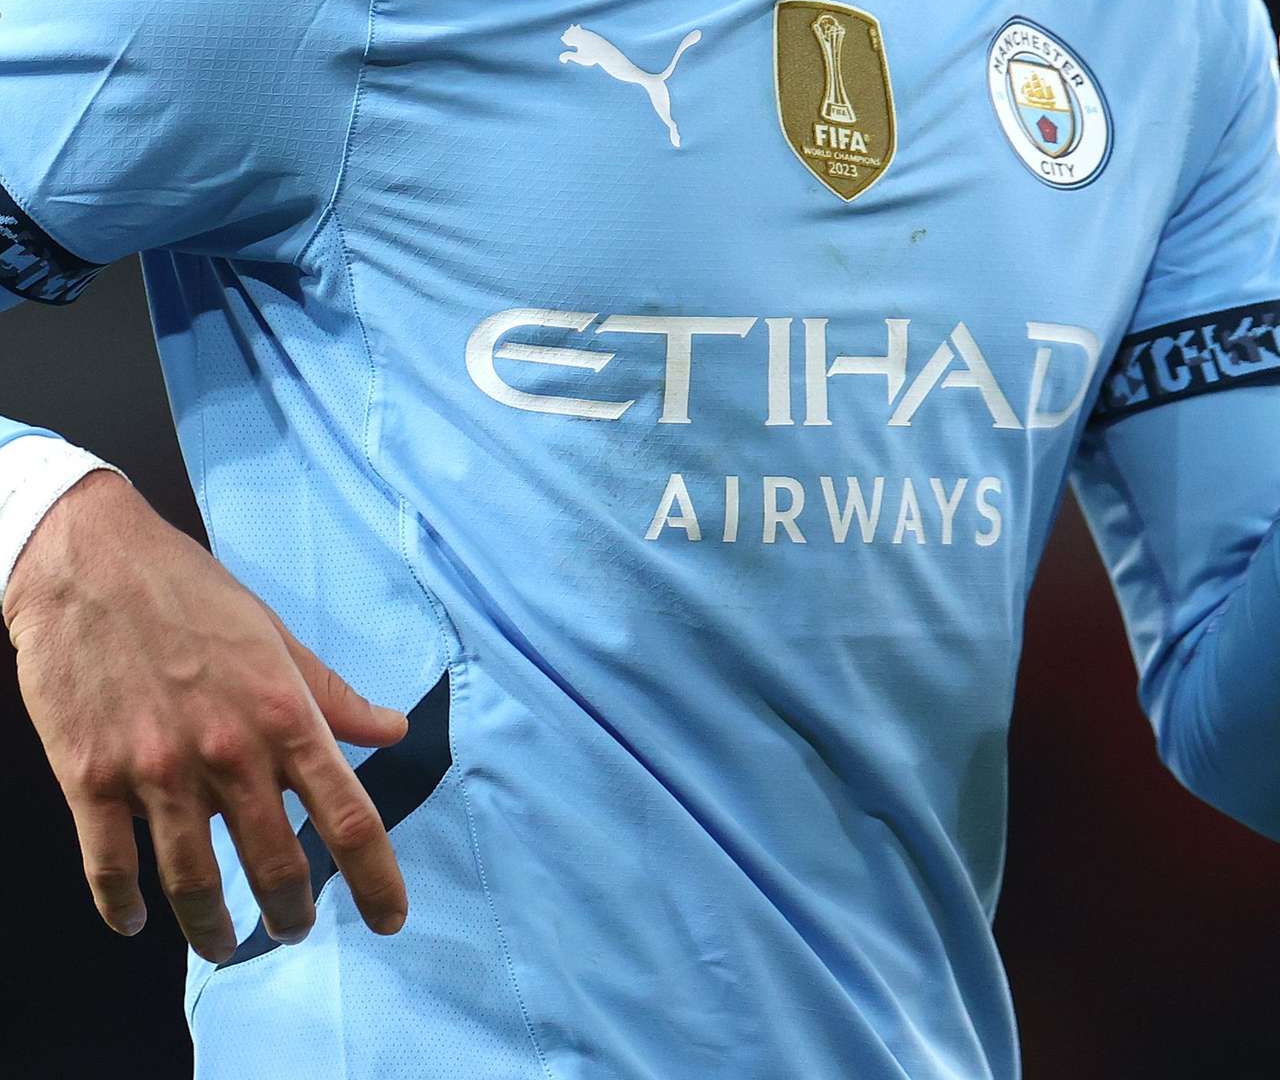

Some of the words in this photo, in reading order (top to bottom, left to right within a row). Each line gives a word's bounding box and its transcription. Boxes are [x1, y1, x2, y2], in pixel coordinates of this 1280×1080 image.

[993, 31, 1085, 88] MANCHESTER
[815, 124, 868, 154] FIFA
[803, 146, 832, 158] WORLD
[833, 151, 880, 166] CHAMPIONS
[828, 161, 858, 178] 2023
[1040, 160, 1076, 178] CITY
[464, 307, 1102, 430] ETIHAD
[644, 473, 1004, 547] AIRWAYS
